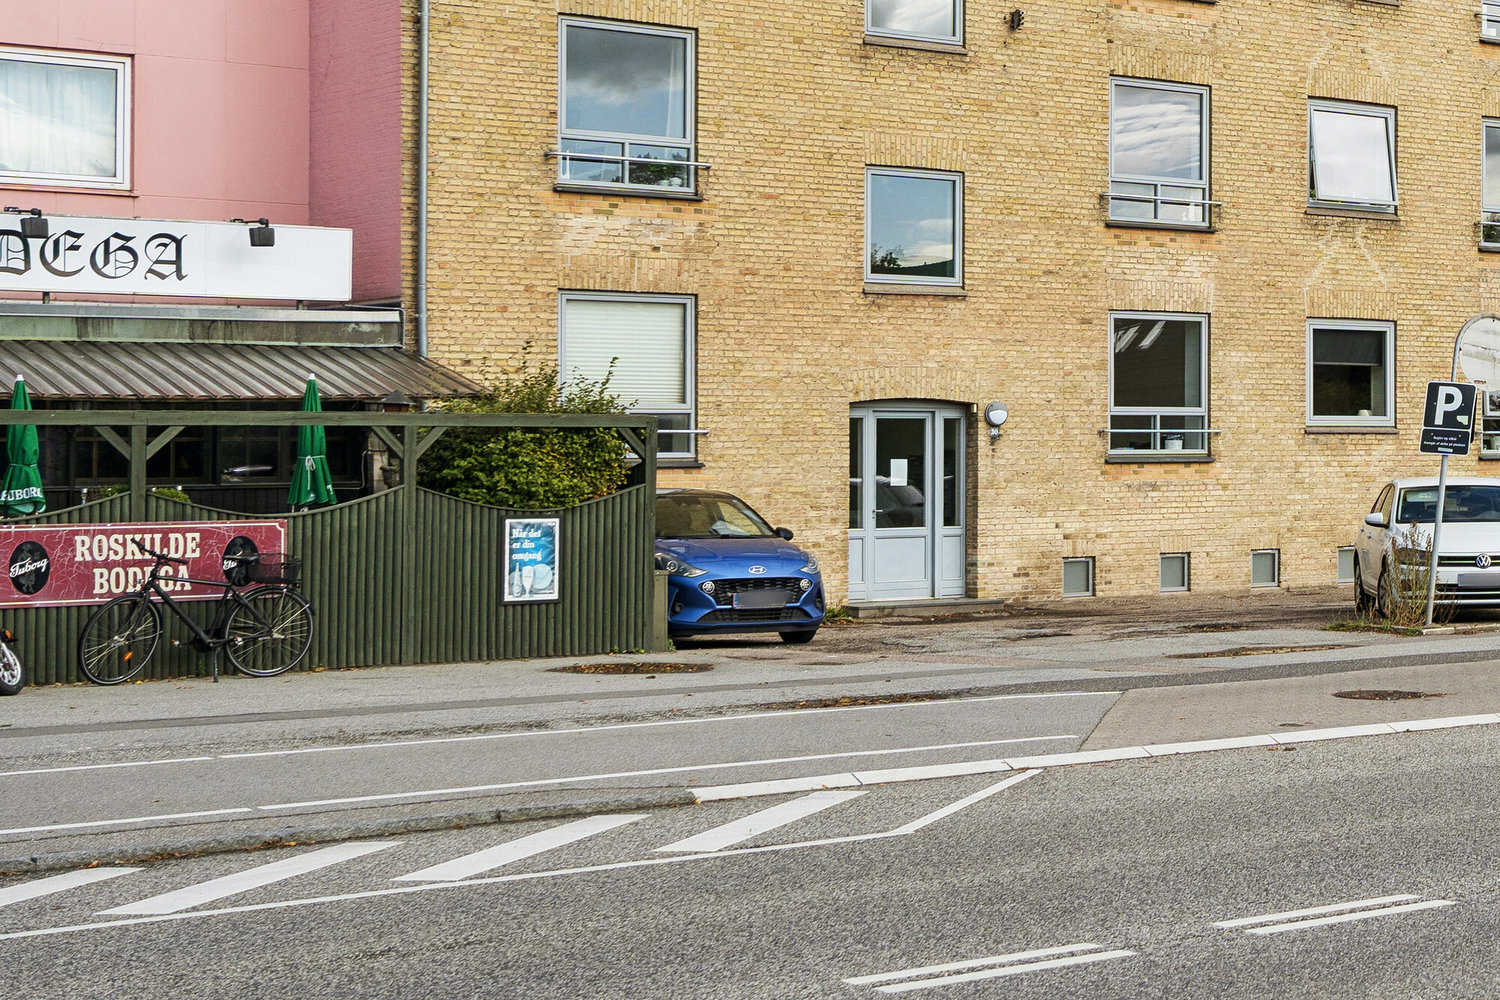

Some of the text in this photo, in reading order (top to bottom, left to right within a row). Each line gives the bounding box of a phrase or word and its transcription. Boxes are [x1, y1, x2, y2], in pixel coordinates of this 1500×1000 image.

[1434, 386, 1463, 425] P
[74, 532, 200, 562] ROSKILDE
[9, 557, 48, 578] Tuborg
